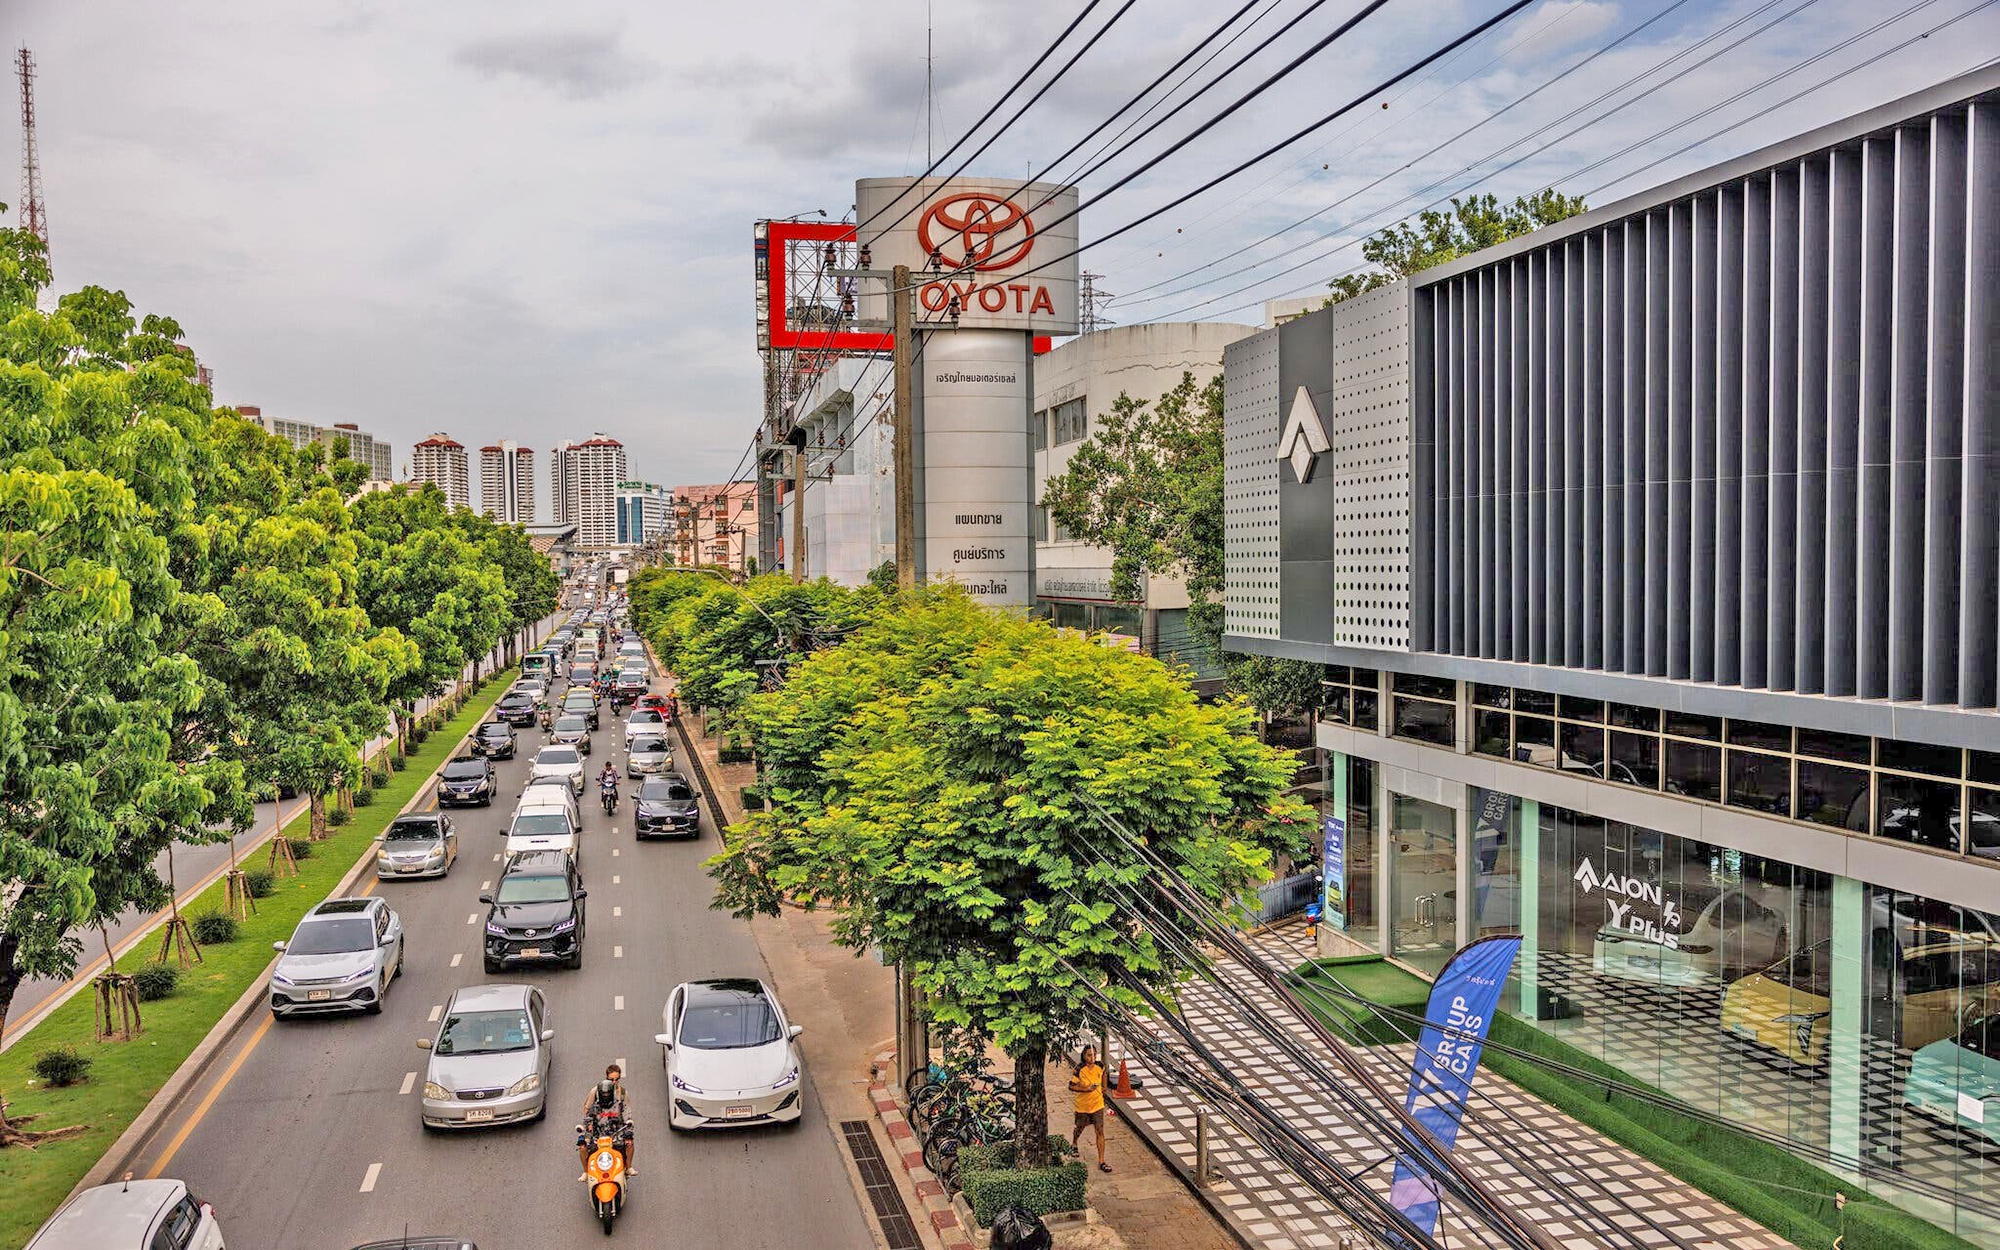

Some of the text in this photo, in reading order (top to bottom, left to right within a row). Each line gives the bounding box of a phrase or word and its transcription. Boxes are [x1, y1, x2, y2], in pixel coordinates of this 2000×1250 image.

[920, 282, 1055, 315] OYOTA
[955, 514, 1002, 525] แผนกขาย
[953, 545, 1005, 563] ศูนย์บริการ
[961, 579, 1007, 594] นกอะไหล่
[1601, 873, 1661, 905] AION
[1606, 898, 1633, 929] Y
[1433, 995, 1470, 1070] GROUP
[1451, 1014, 1483, 1074] CARS
